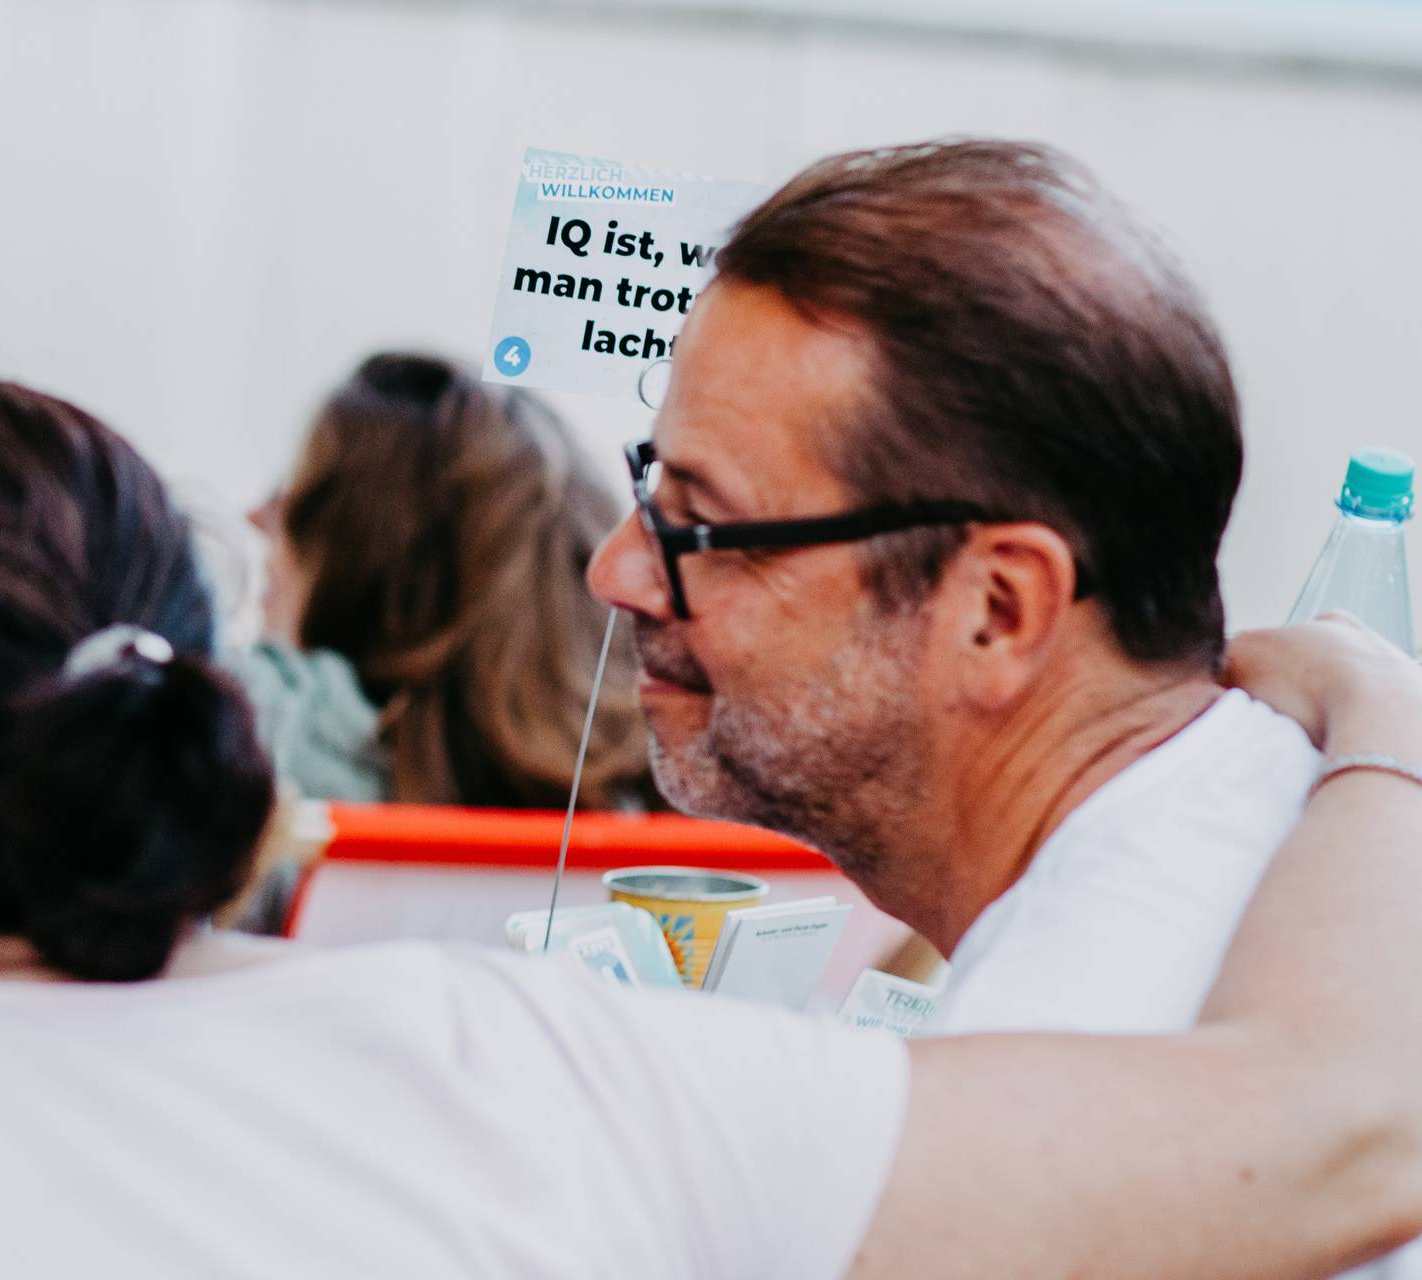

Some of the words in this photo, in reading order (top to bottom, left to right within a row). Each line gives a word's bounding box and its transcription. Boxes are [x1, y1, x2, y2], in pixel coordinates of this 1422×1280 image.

[529, 164, 623, 183] HERZLICH
[541, 183, 674, 202] WILLKOMMEN
[546, 216, 592, 257] IQ
[603, 220, 664, 267] ist,
[680, 242, 717, 267] w
[513, 267, 603, 302] man
[616, 277, 698, 315] trot
[503, 345, 522, 367] 4
